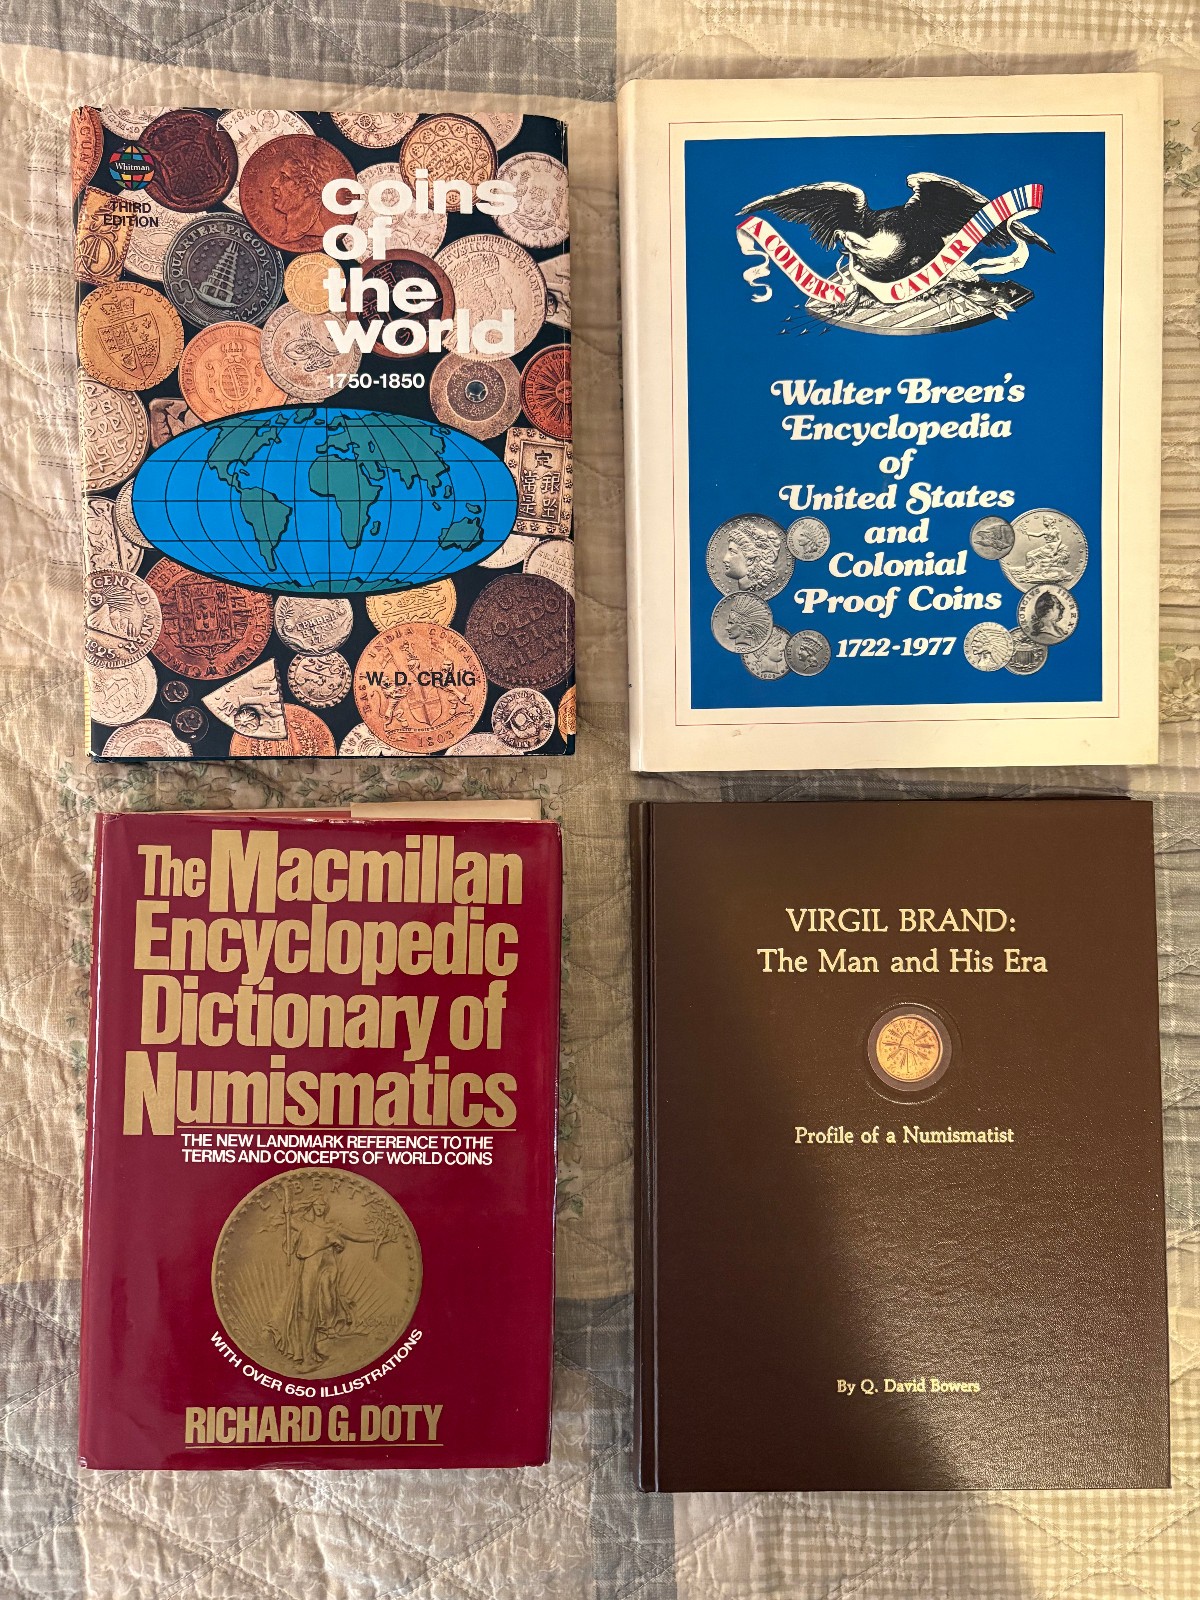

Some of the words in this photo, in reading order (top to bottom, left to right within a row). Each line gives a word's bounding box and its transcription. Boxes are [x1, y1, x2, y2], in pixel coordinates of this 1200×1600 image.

[115, 162, 150, 171] Whitman
[111, 201, 152, 214] THIRD
[321, 169, 517, 216] coins
[103, 214, 160, 228] EDITION
[172, 223, 221, 278] QUARTER
[226, 224, 270, 268] PAGODA
[321, 218, 393, 261] of
[746, 221, 762, 239] A
[764, 236, 848, 303] COINER'S
[889, 238, 972, 302] CAVIAR
[322, 267, 436, 315] the
[325, 308, 516, 355] world
[326, 373, 425, 391] 1750-1850
[770, 380, 891, 406] Walter
[897, 373, 1026, 405] Breen's
[781, 413, 1012, 446] Encyclopedia
[879, 448, 918, 480] of
[778, 483, 897, 512] United
[906, 483, 1016, 515] States
[864, 520, 929, 545] and
[828, 550, 968, 579] Colonial
[793, 586, 901, 619] Proof
[909, 584, 1003, 611] Coins
[836, 636, 957, 659] 1722-1977
[365, 671, 389, 687] W.
[395, 671, 412, 687] D.
[417, 671, 477, 687] CRAIG
[138, 845, 207, 898] The
[209, 829, 524, 914] Macmillan
[785, 908, 889, 934] VIRGIL
[899, 908, 1018, 934] BRAND:
[133, 900, 519, 985] Encyclopedic
[756, 948, 808, 974] The
[818, 948, 880, 974] Man
[890, 948, 940, 974] and
[949, 948, 994, 974] His
[1004, 948, 1048, 974] Era
[140, 974, 440, 1061] Dictionary
[448, 979, 508, 1050] of
[122, 1051, 518, 1136] Numismatics
[181, 1134, 214, 1148] THE
[216, 1134, 255, 1148] NEW
[257, 1134, 344, 1149] LANDMARK
[347, 1135, 439, 1150] REFERENCE
[441, 1135, 462, 1150] TO
[462, 1135, 494, 1150] THE
[794, 1125, 855, 1145] Profile
[861, 1125, 879, 1145] of
[885, 1131, 897, 1145] a
[902, 1125, 1015, 1145] Numismatist
[181, 1148, 235, 1164] TERMS
[237, 1149, 271, 1164] AND
[274, 1149, 359, 1165] CONCEPTS
[362, 1150, 386, 1165] OF
[387, 1150, 443, 1165] WORLD
[444, 1150, 493, 1166] COINS
[210, 1330, 242, 1369] WITH
[242, 1364, 283, 1392] OVER
[284, 1383, 316, 1398] 650
[319, 1327, 424, 1398] ILLUSTRATIONS
[836, 1378, 857, 1396] By
[860, 1378, 879, 1396] Q.
[883, 1377, 927, 1394] David
[930, 1377, 981, 1394] Bowers
[184, 1406, 320, 1444] RICHARD
[327, 1406, 357, 1442] G.
[359, 1404, 444, 1442] DOTY
